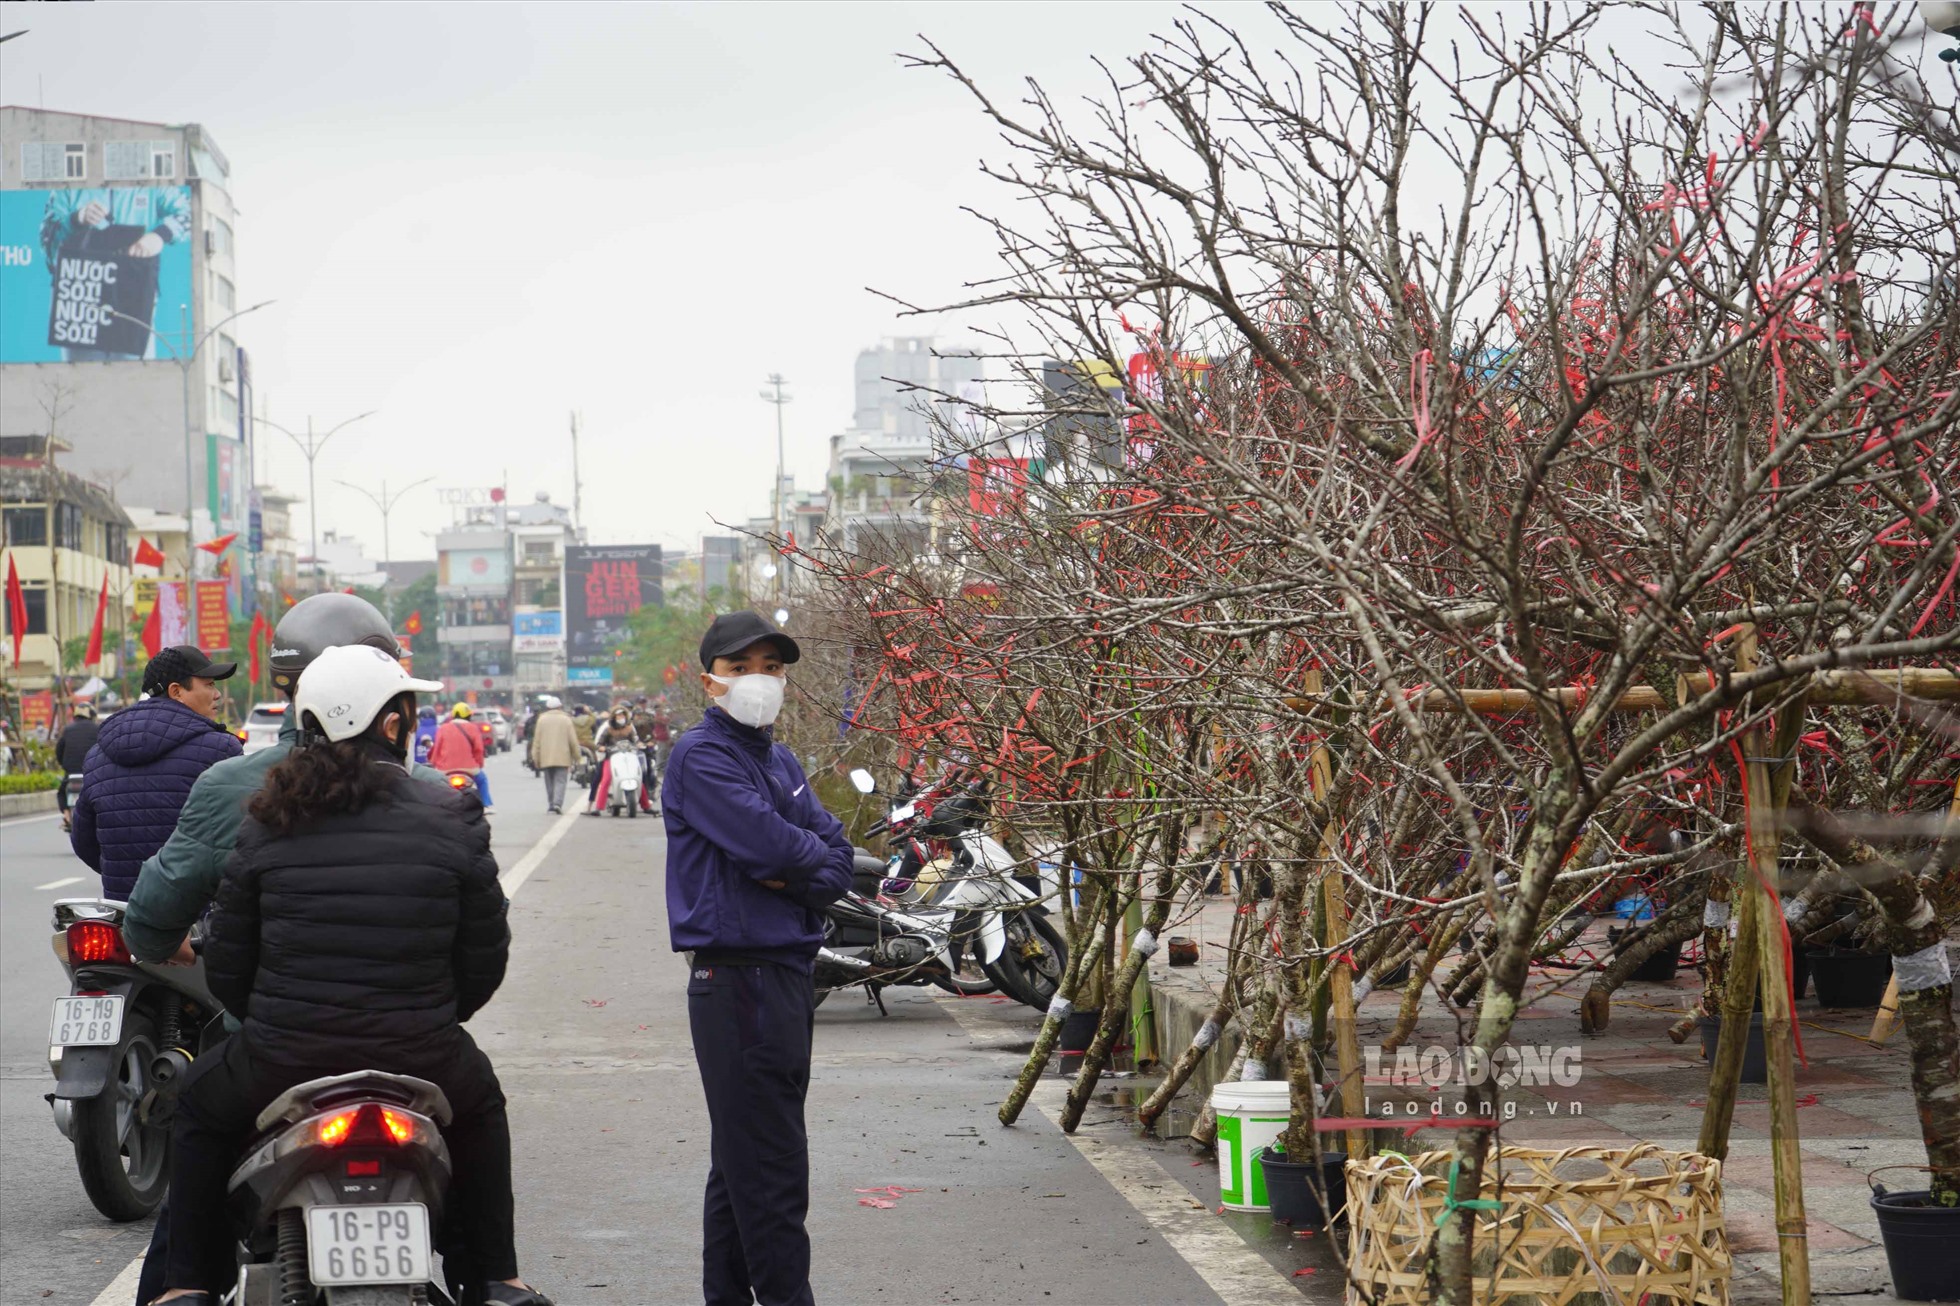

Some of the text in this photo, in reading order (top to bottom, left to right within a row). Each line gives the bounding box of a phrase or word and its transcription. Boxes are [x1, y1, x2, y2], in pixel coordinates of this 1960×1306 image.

[57, 279, 102, 303] SÔI!
[54, 320, 98, 345] SÔI!
[65, 999, 114, 1020] 16-M9
[60, 1021, 111, 1042] 6768
[329, 1210, 410, 1242] 16-P9
[328, 1246, 413, 1278] 6656
